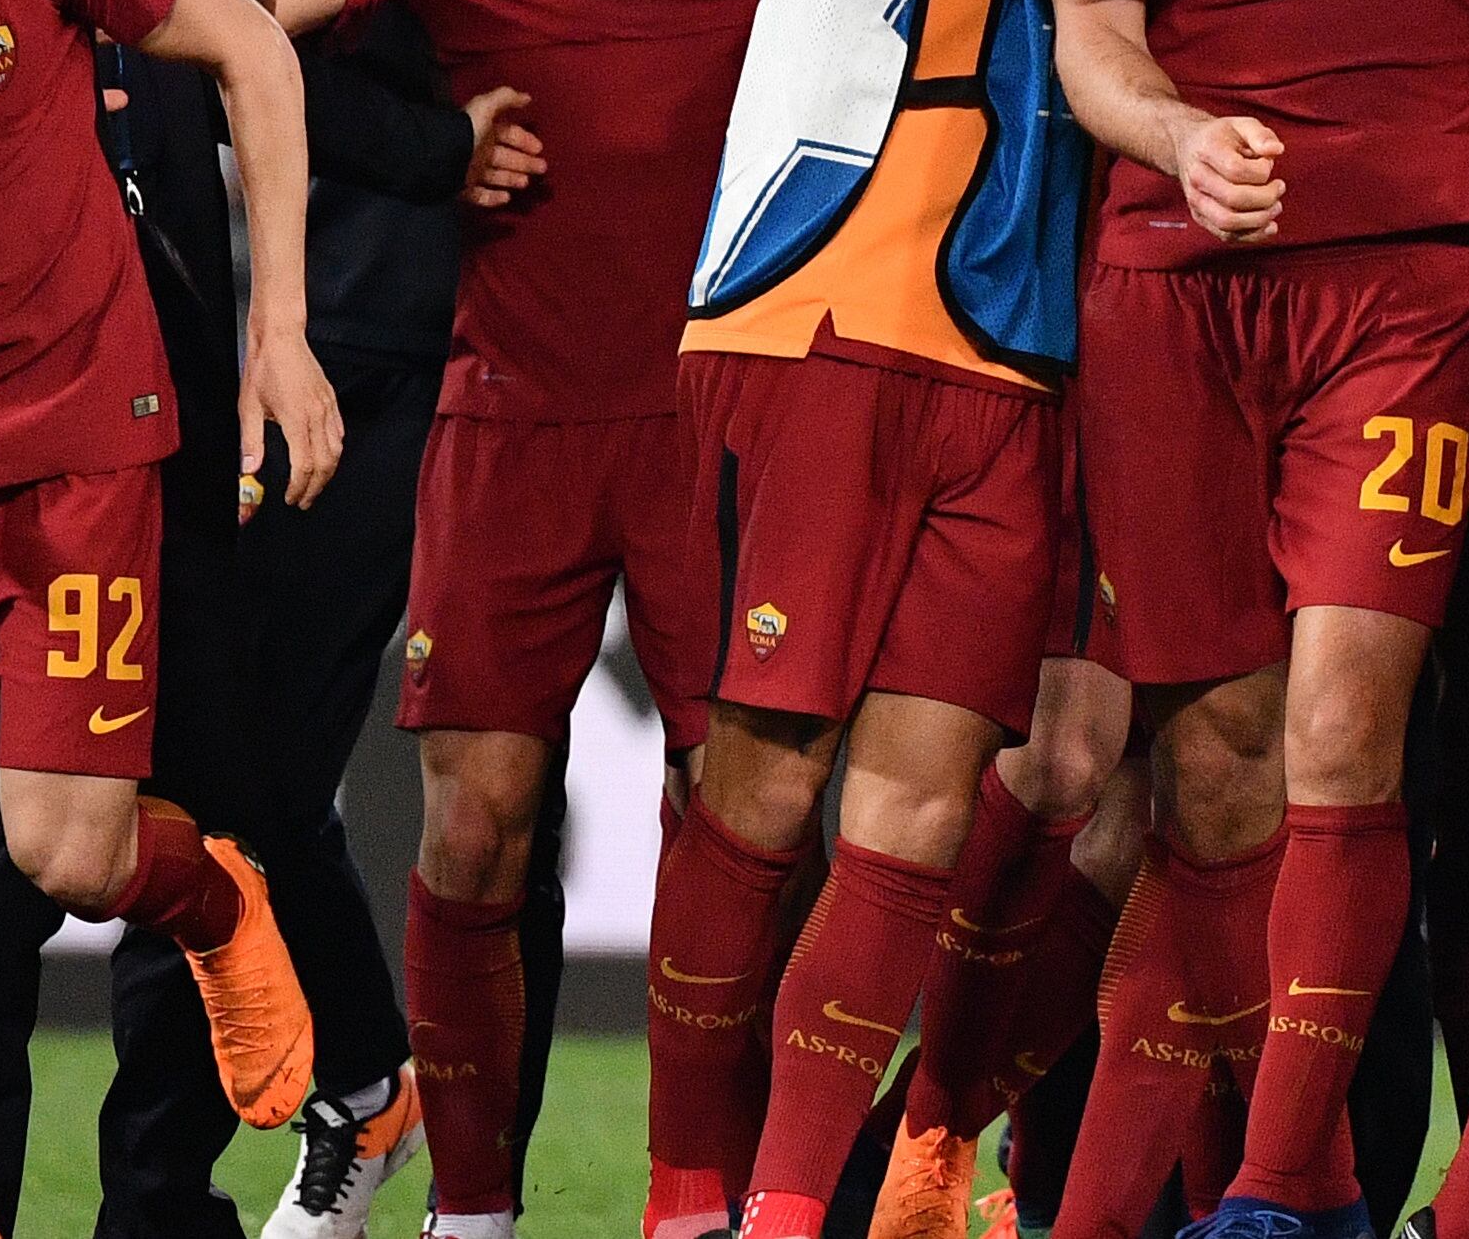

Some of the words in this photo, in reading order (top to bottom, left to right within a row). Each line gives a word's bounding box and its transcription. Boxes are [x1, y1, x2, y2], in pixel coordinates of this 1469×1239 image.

[1358, 415, 1469, 526] 20
[46, 573, 144, 681] 92
[749, 633, 777, 648] ROMA
